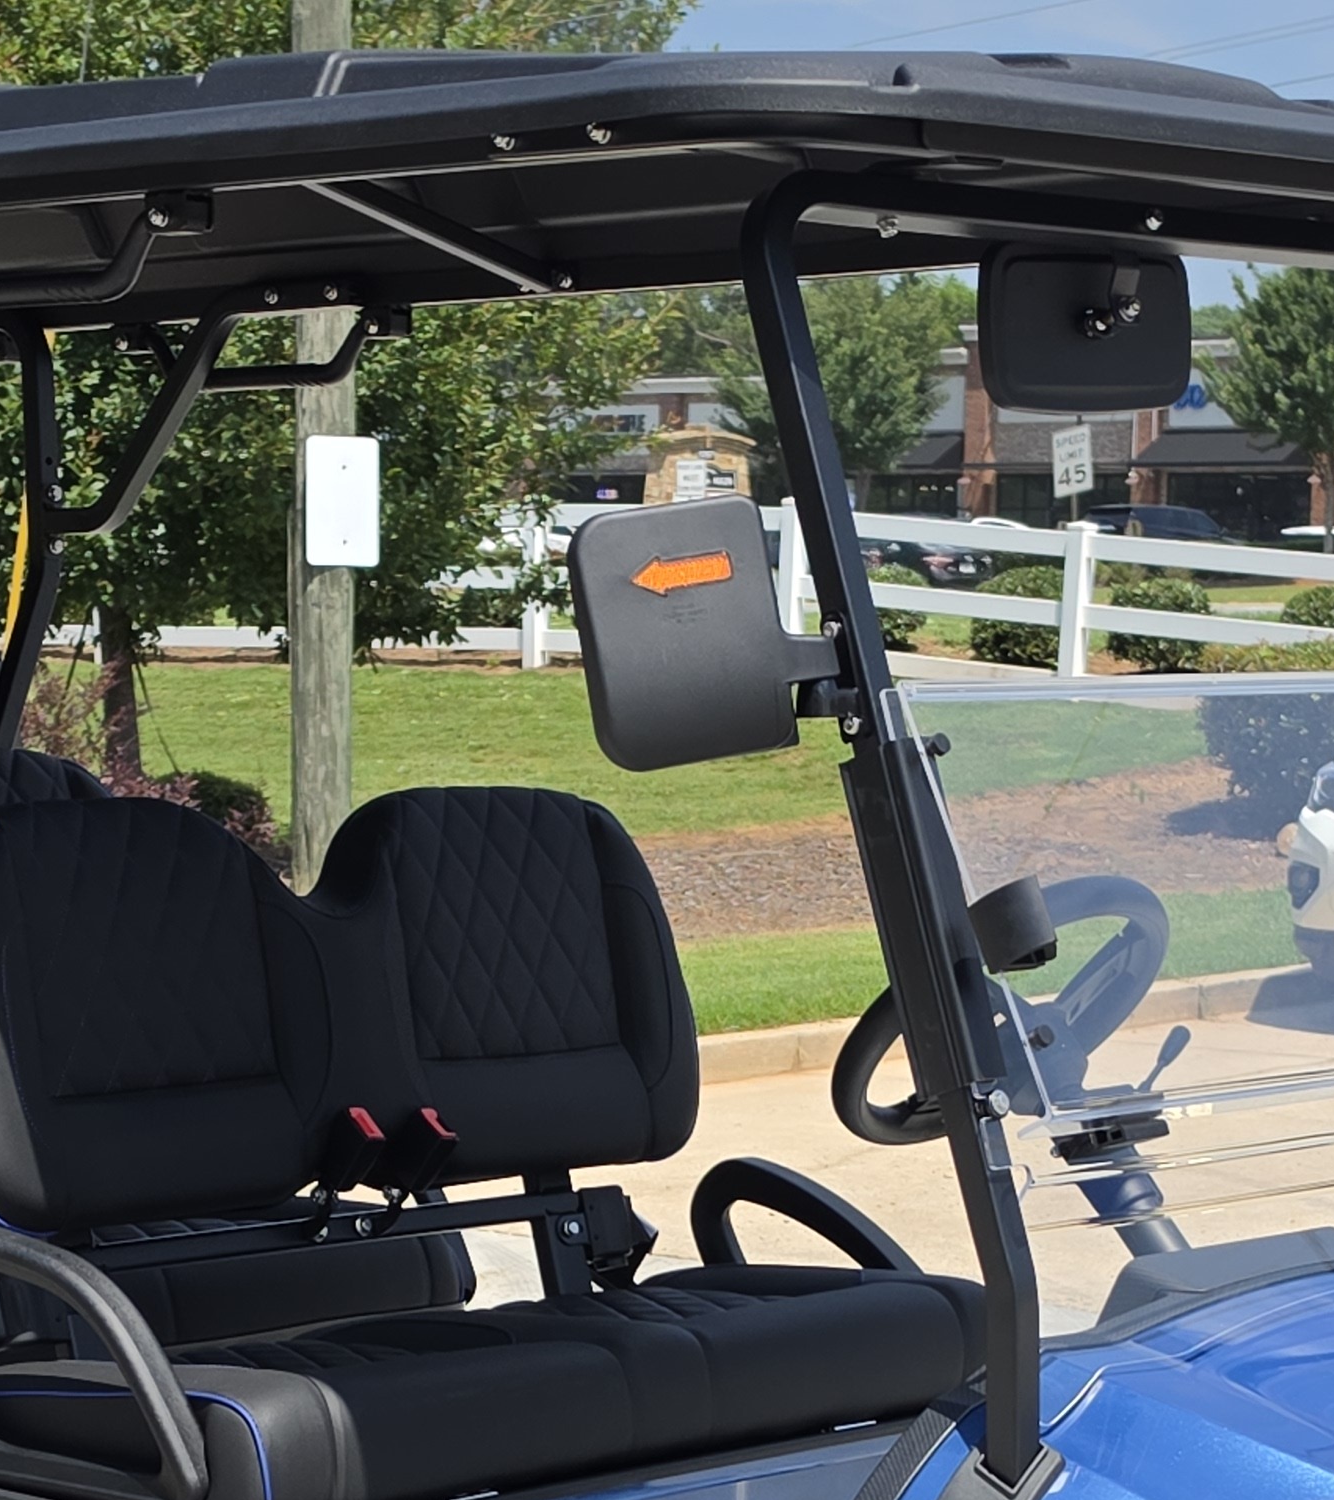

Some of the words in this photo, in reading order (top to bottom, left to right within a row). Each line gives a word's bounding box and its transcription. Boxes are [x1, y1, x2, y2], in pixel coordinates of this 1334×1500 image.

[1055, 432, 1086, 449] SPEED
[1058, 448, 1085, 463] LIMIT
[1057, 464, 1087, 486] 45
